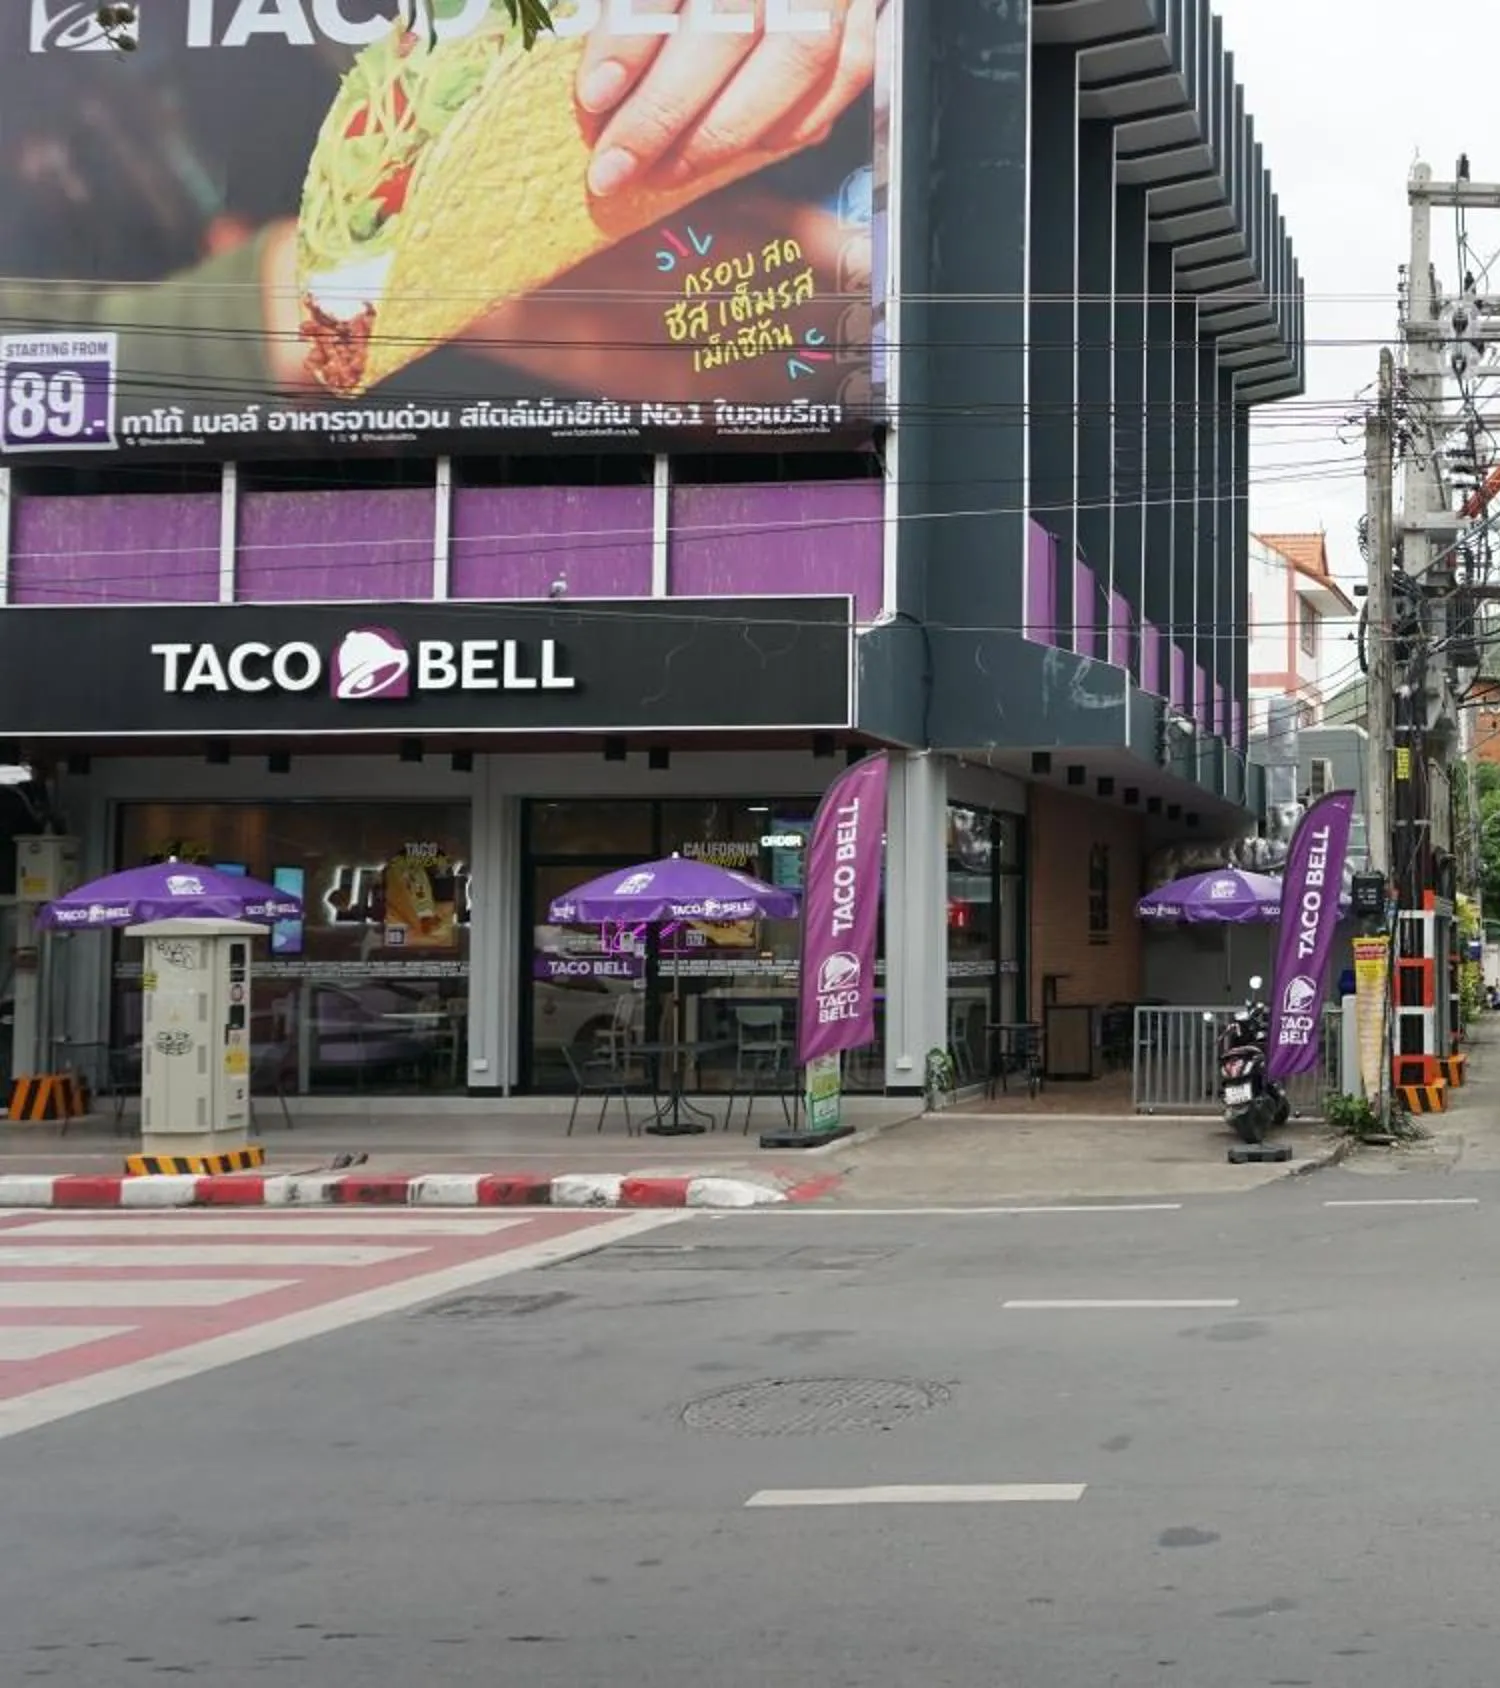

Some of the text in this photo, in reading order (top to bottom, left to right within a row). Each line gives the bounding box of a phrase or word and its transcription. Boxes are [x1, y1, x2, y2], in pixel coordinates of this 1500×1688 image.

[685, 240, 801, 298] กรอบ สด
[6, 341, 108, 358] STARTING FROM
[8, 370, 105, 438] 89.-
[121, 406, 185, 435] ทาโก้
[193, 404, 260, 434] เบลล์
[267, 403, 449, 431] อาหารจานด่วน
[641, 402, 704, 426] No.1
[151, 639, 575, 692] TACO BELL
[683, 842, 758, 858] CALIFORNIA
[832, 797, 860, 937] TACO BELL
[1298, 825, 1330, 959] TACO BELL
[56, 908, 87, 921] TACO
[671, 904, 700, 916] TACO
[548, 961, 633, 975] TACO BELL
[816, 990, 860, 1023] TACO BELL
